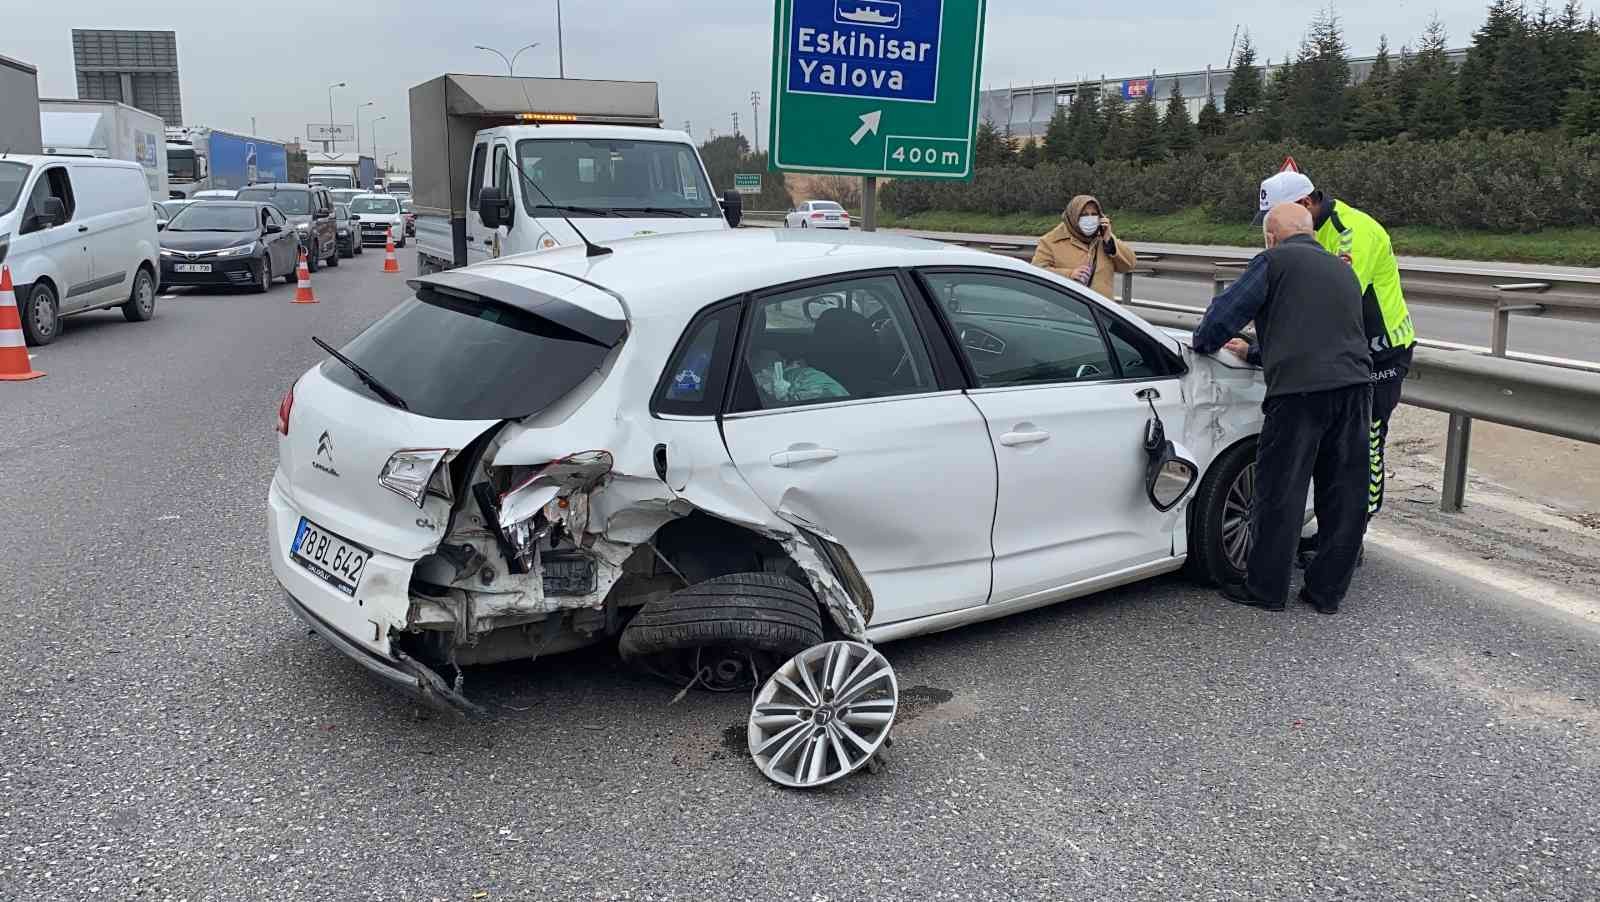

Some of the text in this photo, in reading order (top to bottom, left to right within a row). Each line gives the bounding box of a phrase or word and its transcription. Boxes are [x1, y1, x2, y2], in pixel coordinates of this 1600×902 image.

[798, 27, 931, 62] Eskihisar
[798, 59, 904, 91] Yalova
[299, 526, 318, 555] 78
[314, 535, 332, 566] BL
[332, 545, 364, 583] 642
